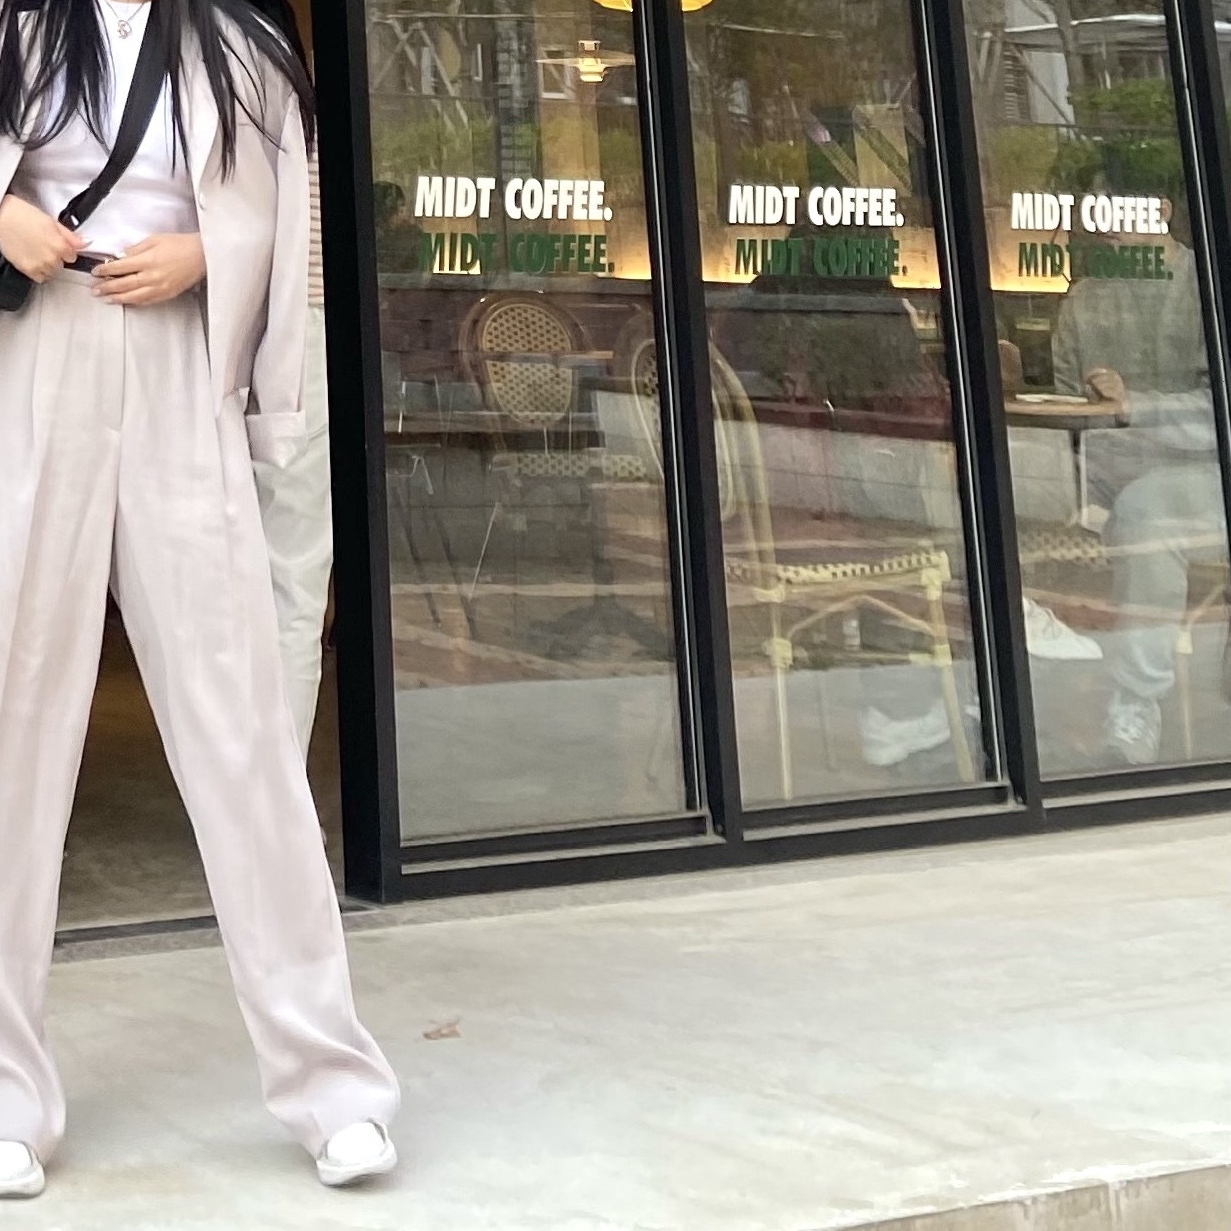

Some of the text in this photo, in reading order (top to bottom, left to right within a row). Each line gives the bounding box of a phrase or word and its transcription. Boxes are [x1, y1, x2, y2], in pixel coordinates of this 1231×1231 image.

[414, 176, 613, 220] MIDT COFFEE.
[729, 185, 905, 227] MIDT COFFEE.
[1011, 193, 1169, 234] MIDT COFFEE.
